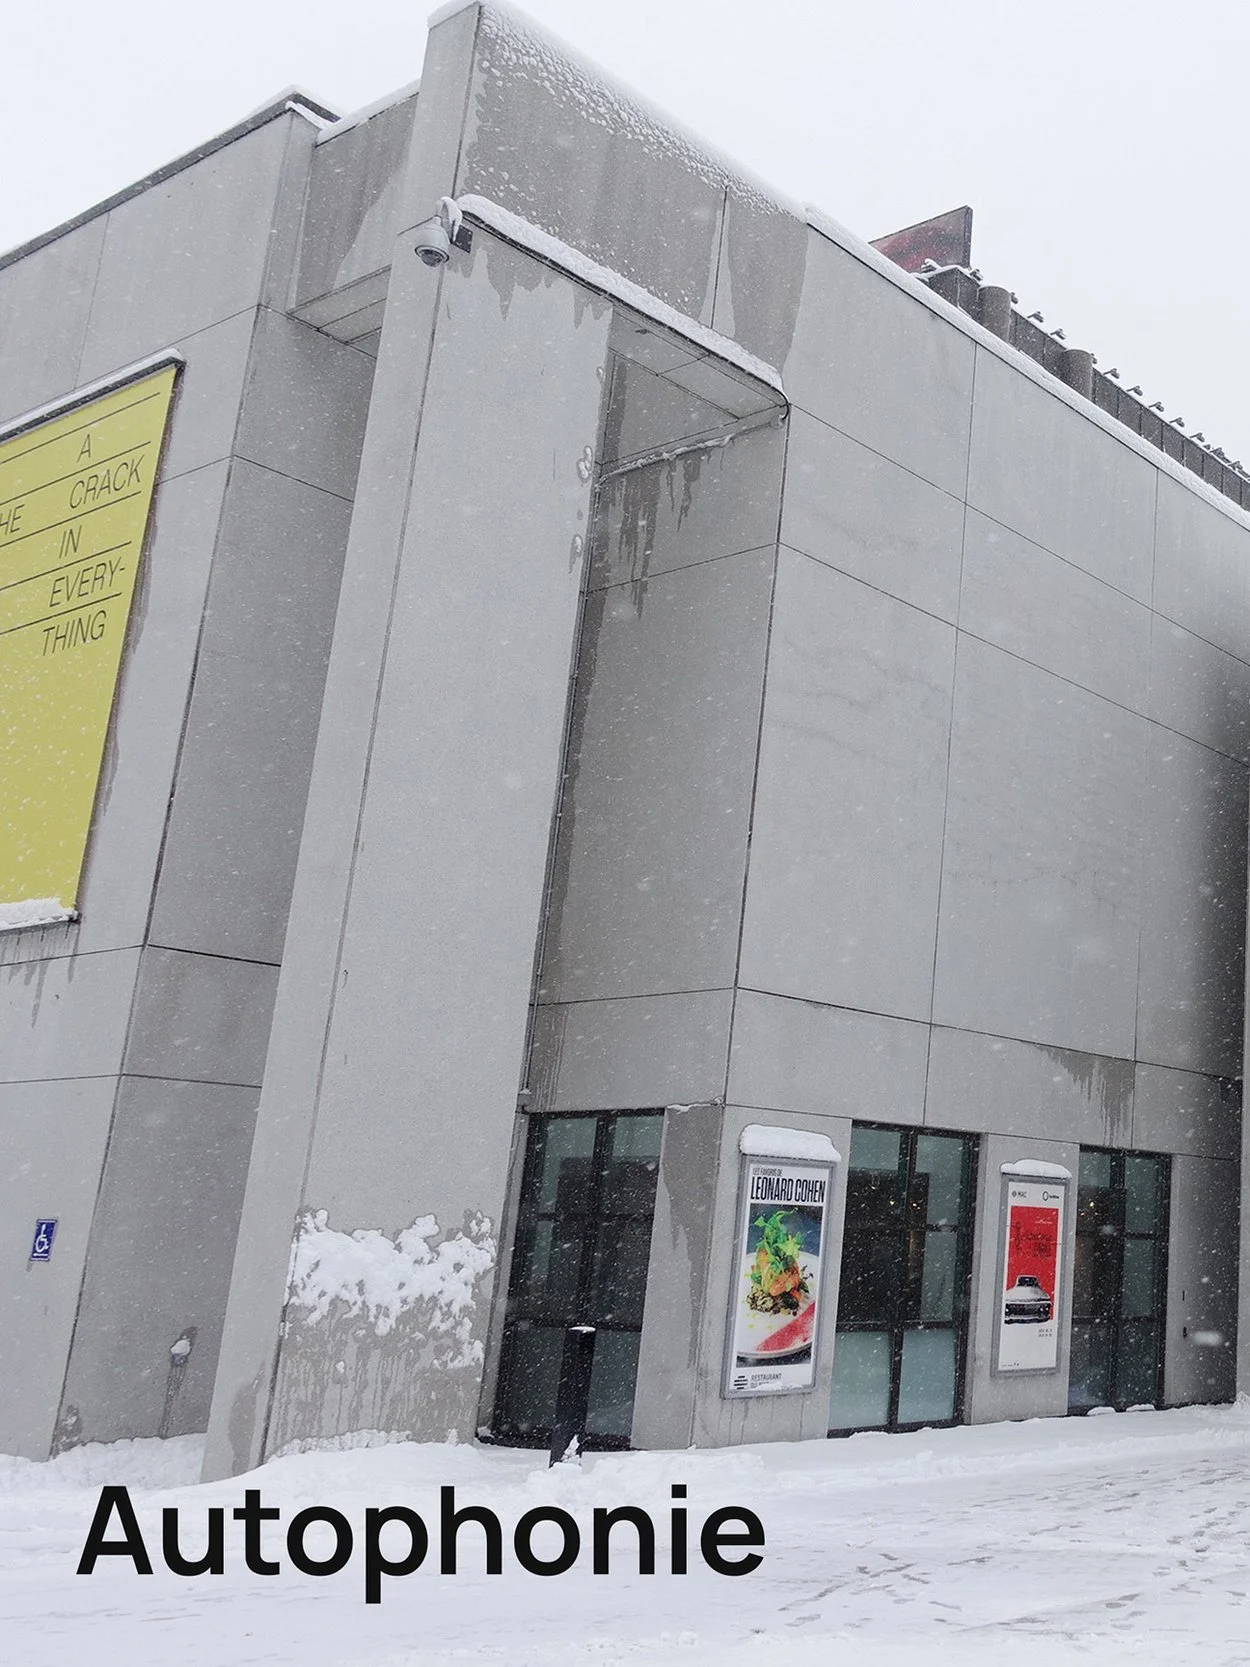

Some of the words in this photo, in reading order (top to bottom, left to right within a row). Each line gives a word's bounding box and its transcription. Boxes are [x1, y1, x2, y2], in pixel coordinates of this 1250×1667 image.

[77, 434, 92, 462] A
[69, 455, 146, 509] CRACK
[59, 525, 82, 559] IN
[50, 557, 125, 608] EVERY-
[43, 610, 107, 656] THING
[751, 1176, 794, 1201] LEONARD
[795, 1179, 825, 1203] COHEN
